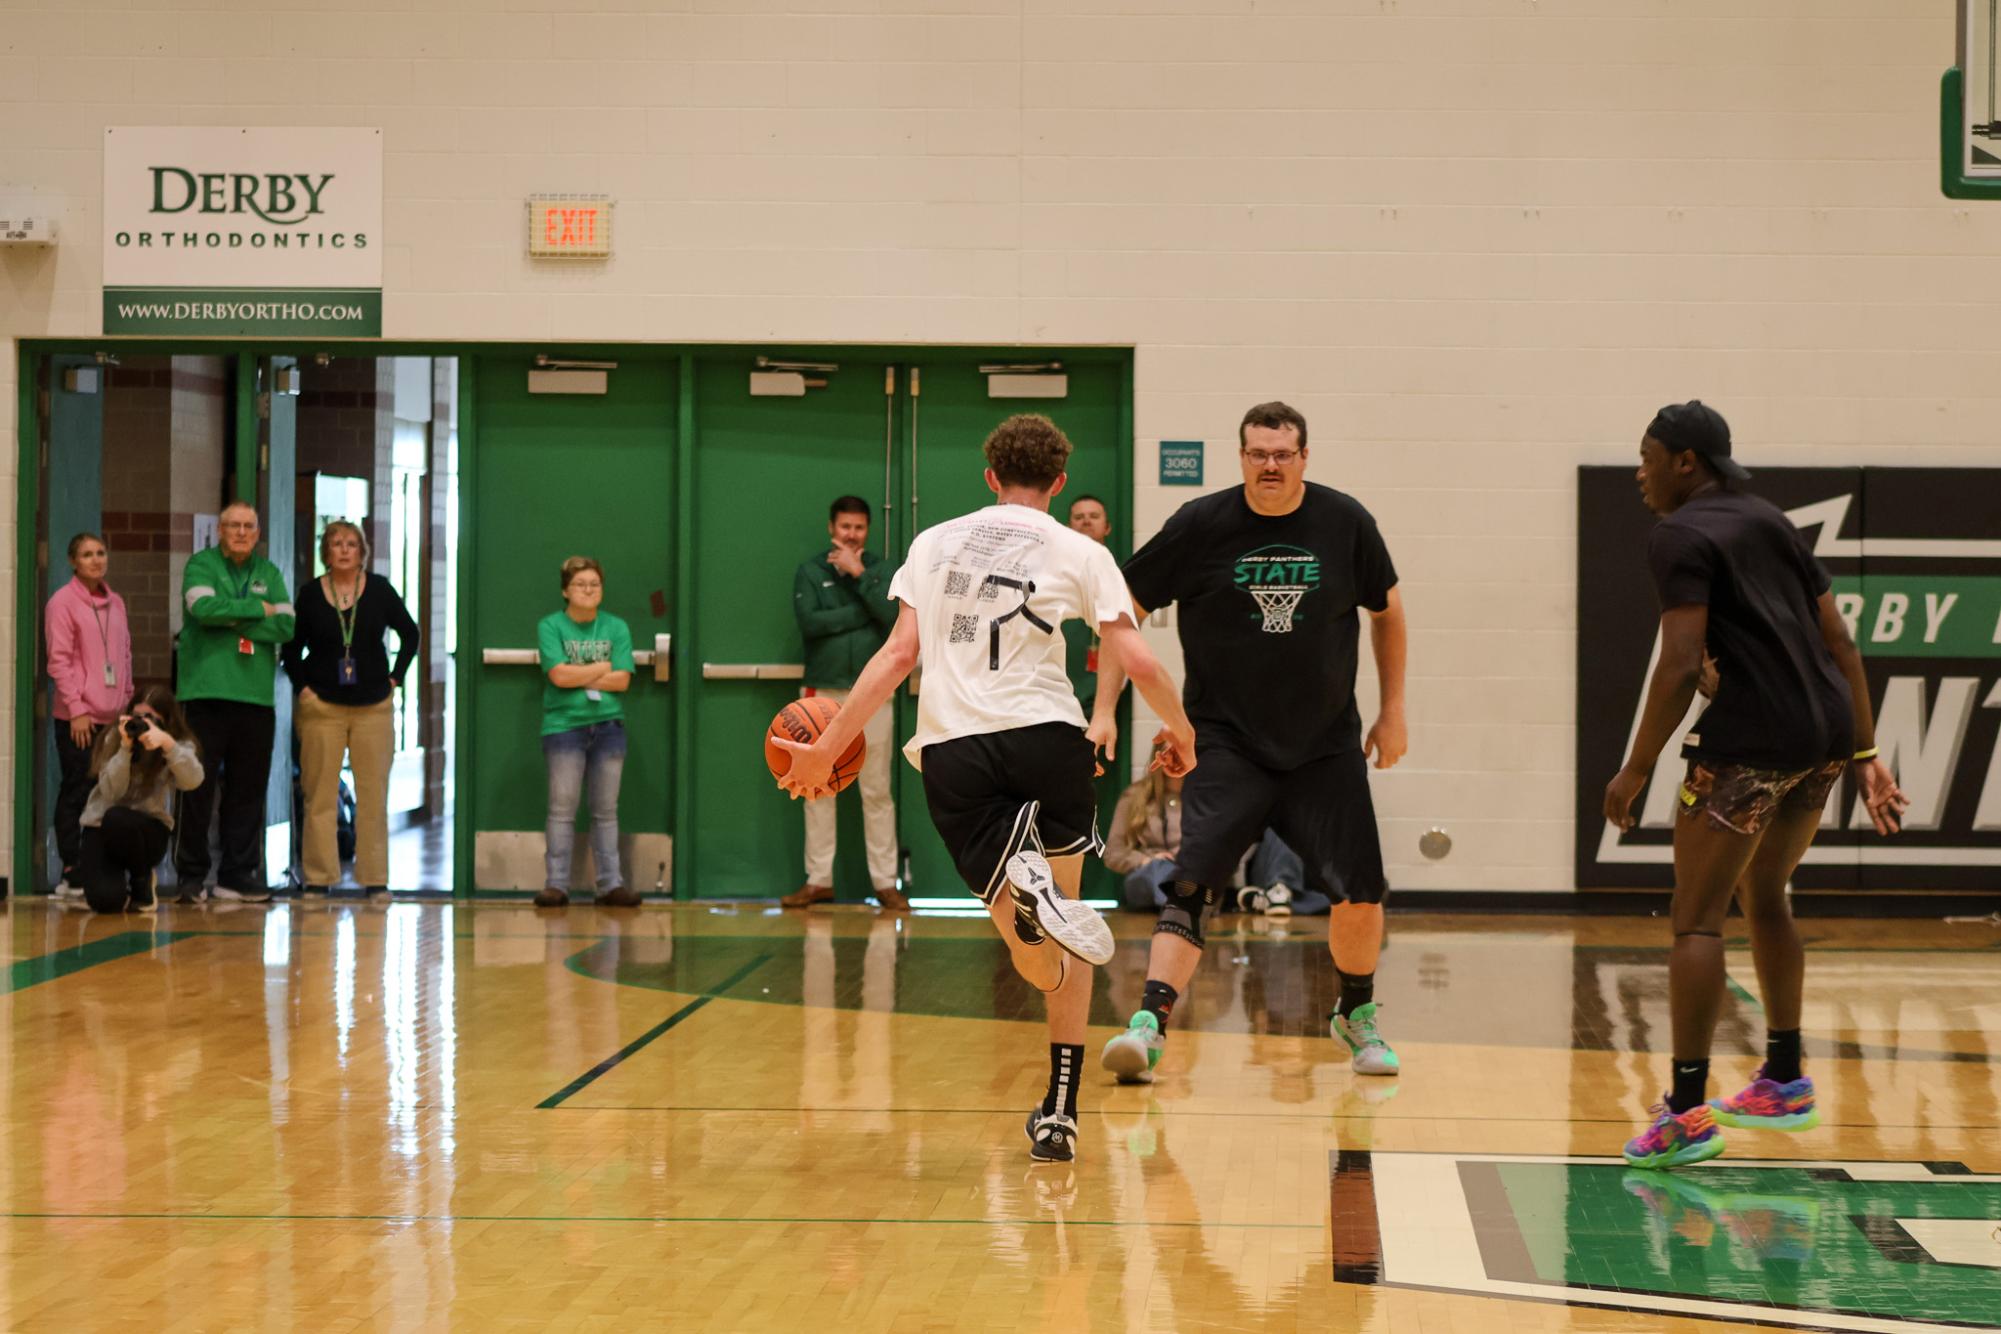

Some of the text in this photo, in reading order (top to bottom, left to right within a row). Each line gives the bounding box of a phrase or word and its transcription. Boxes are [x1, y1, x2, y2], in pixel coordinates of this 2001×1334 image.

[147, 166, 335, 226] DERBY
[545, 207, 598, 247] EXIT
[115, 231, 368, 248] ORTHODONTICS
[118, 302, 364, 321] WWW.DERBYORTHO.COM
[1165, 457, 1198, 469] 3060
[1233, 562, 1320, 585] STATE
[1834, 593, 1958, 643] RBY
